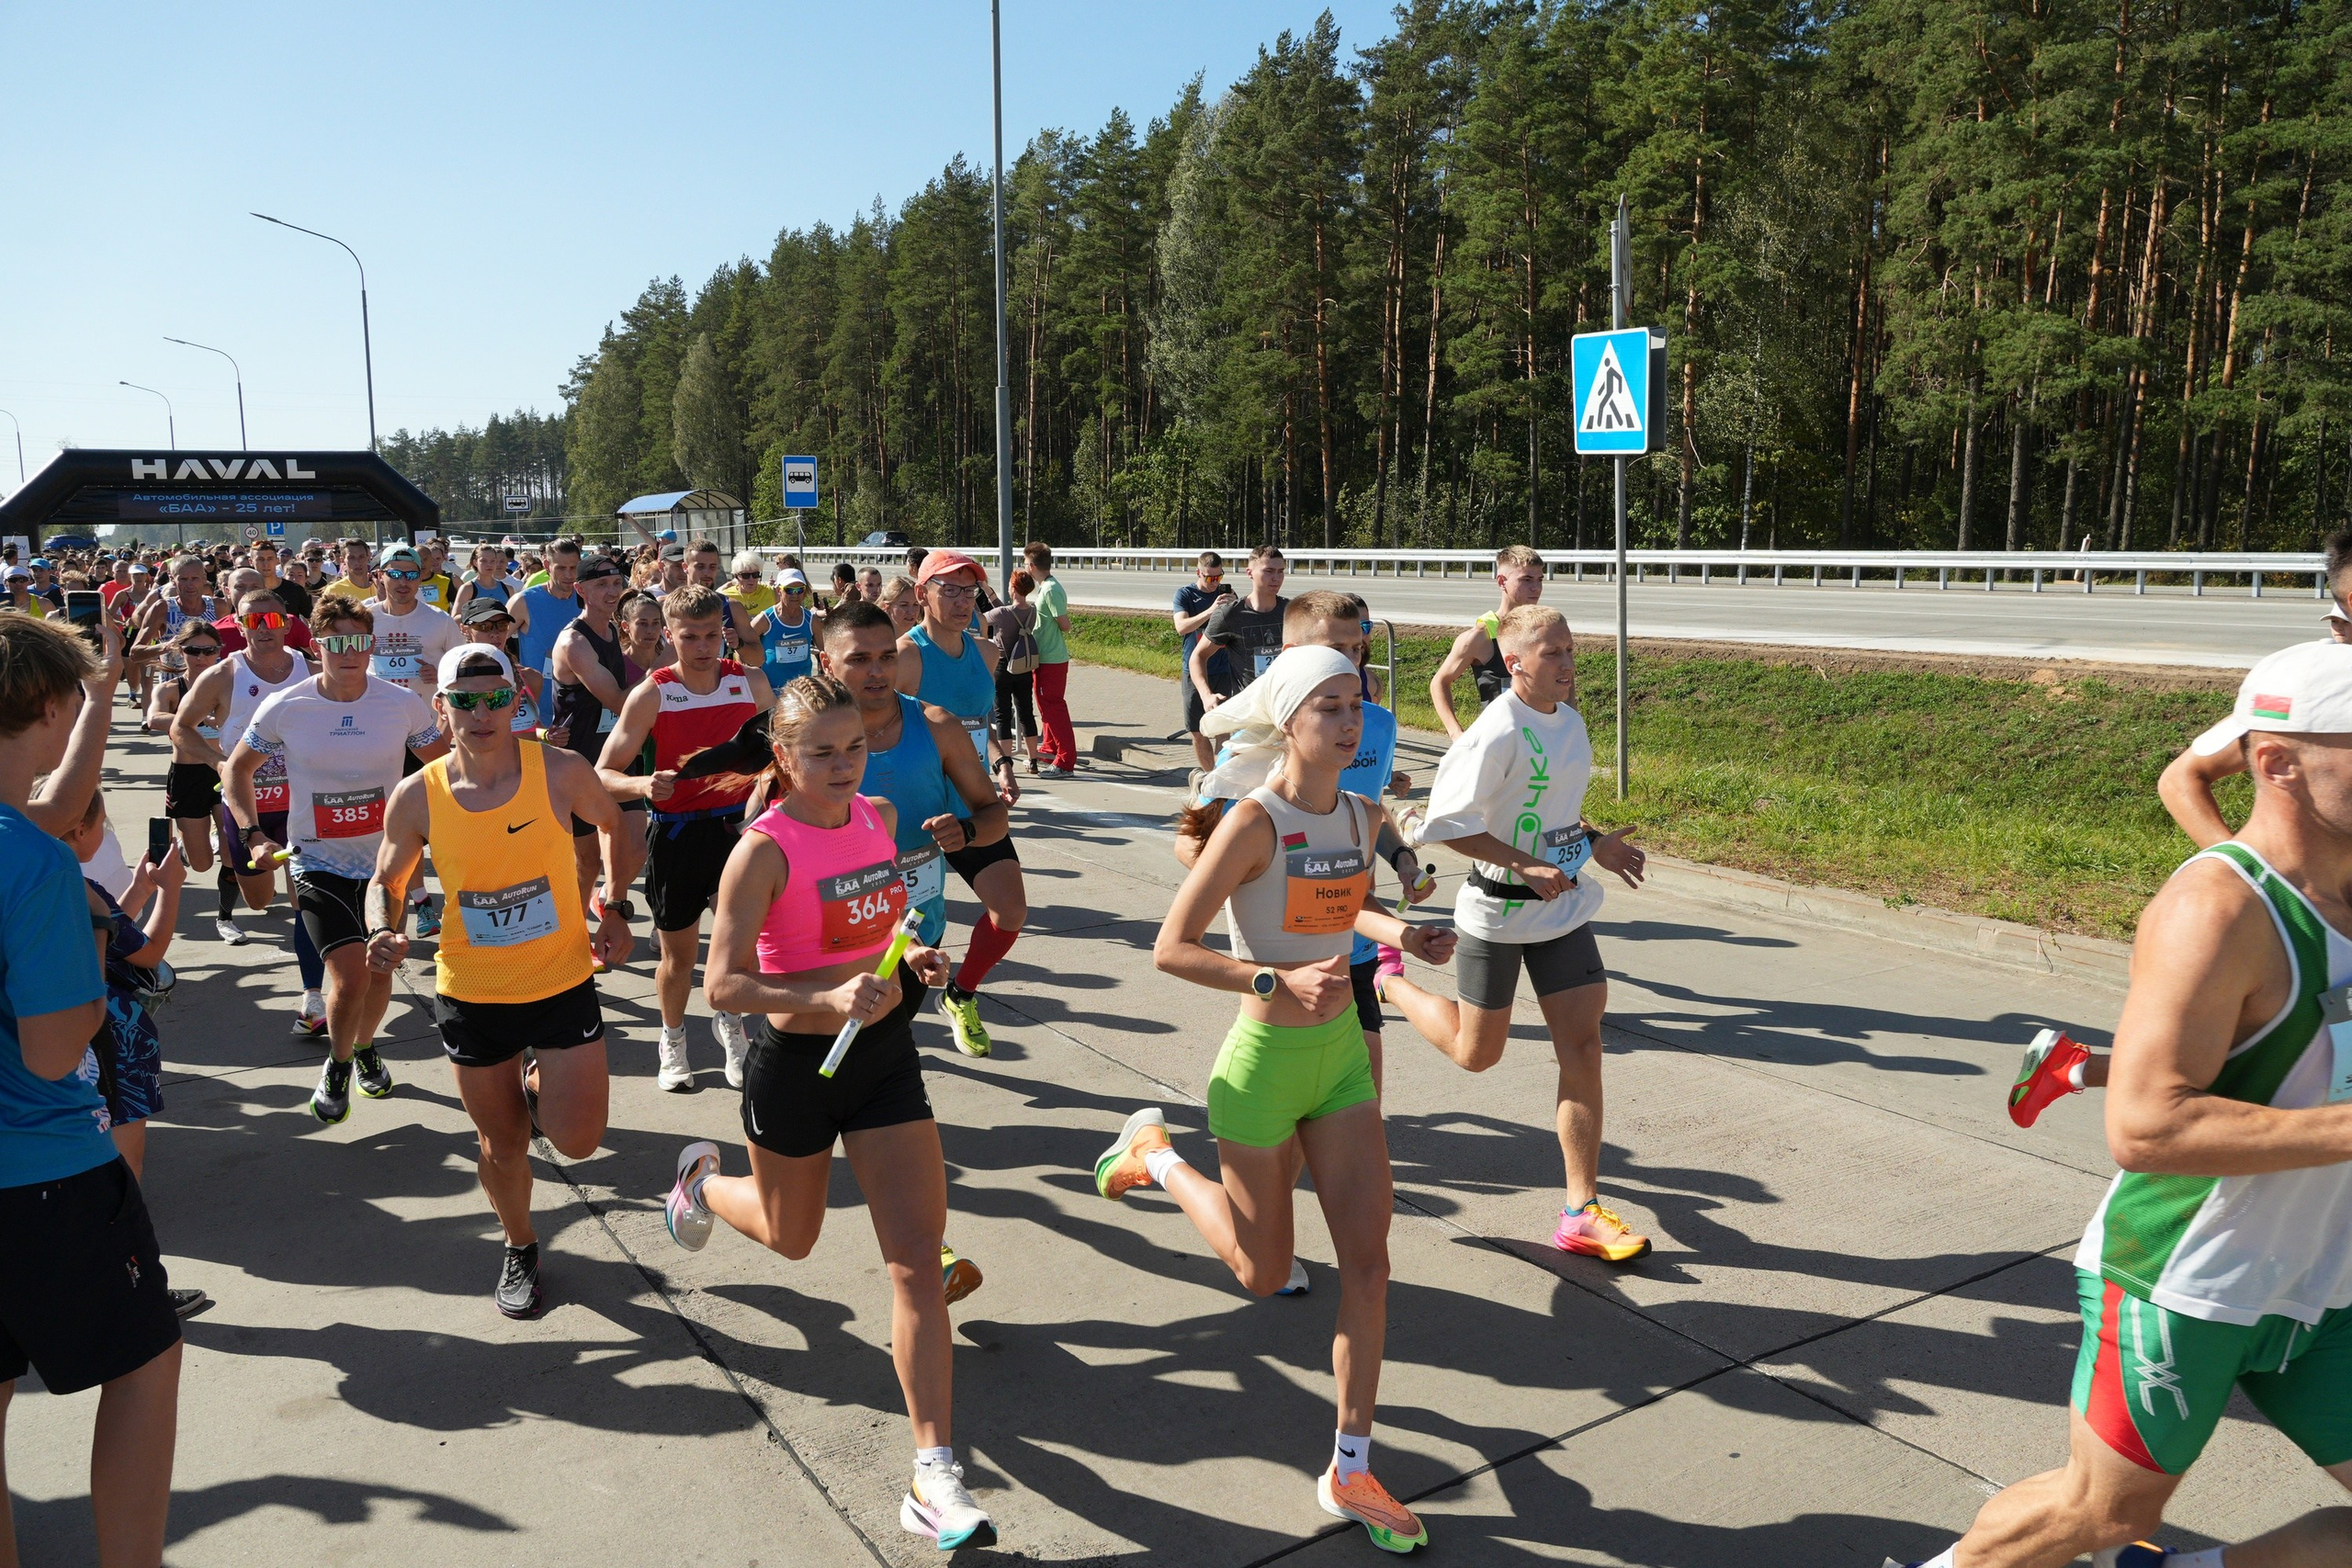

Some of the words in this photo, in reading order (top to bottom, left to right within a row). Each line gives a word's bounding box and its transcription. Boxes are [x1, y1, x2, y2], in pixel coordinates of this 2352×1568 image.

[131, 458, 316, 479] HAVAL
[132, 493, 236, 502] Автомобильная
[241, 494, 313, 502] ассоциация
[159, 503, 216, 513] «БАА»
[235, 503, 257, 513] 25
[263, 503, 295, 513] лет!
[389, 657, 406, 667] 60
[1266, 656, 1277, 666] 2
[254, 786, 283, 800] 379
[332, 806, 369, 823] 385
[1556, 842, 1582, 864] 259
[889, 885, 903, 895] PRO
[847, 891, 890, 925] 364
[1337, 905, 1348, 913] PRO
[487, 902, 528, 928] 177
